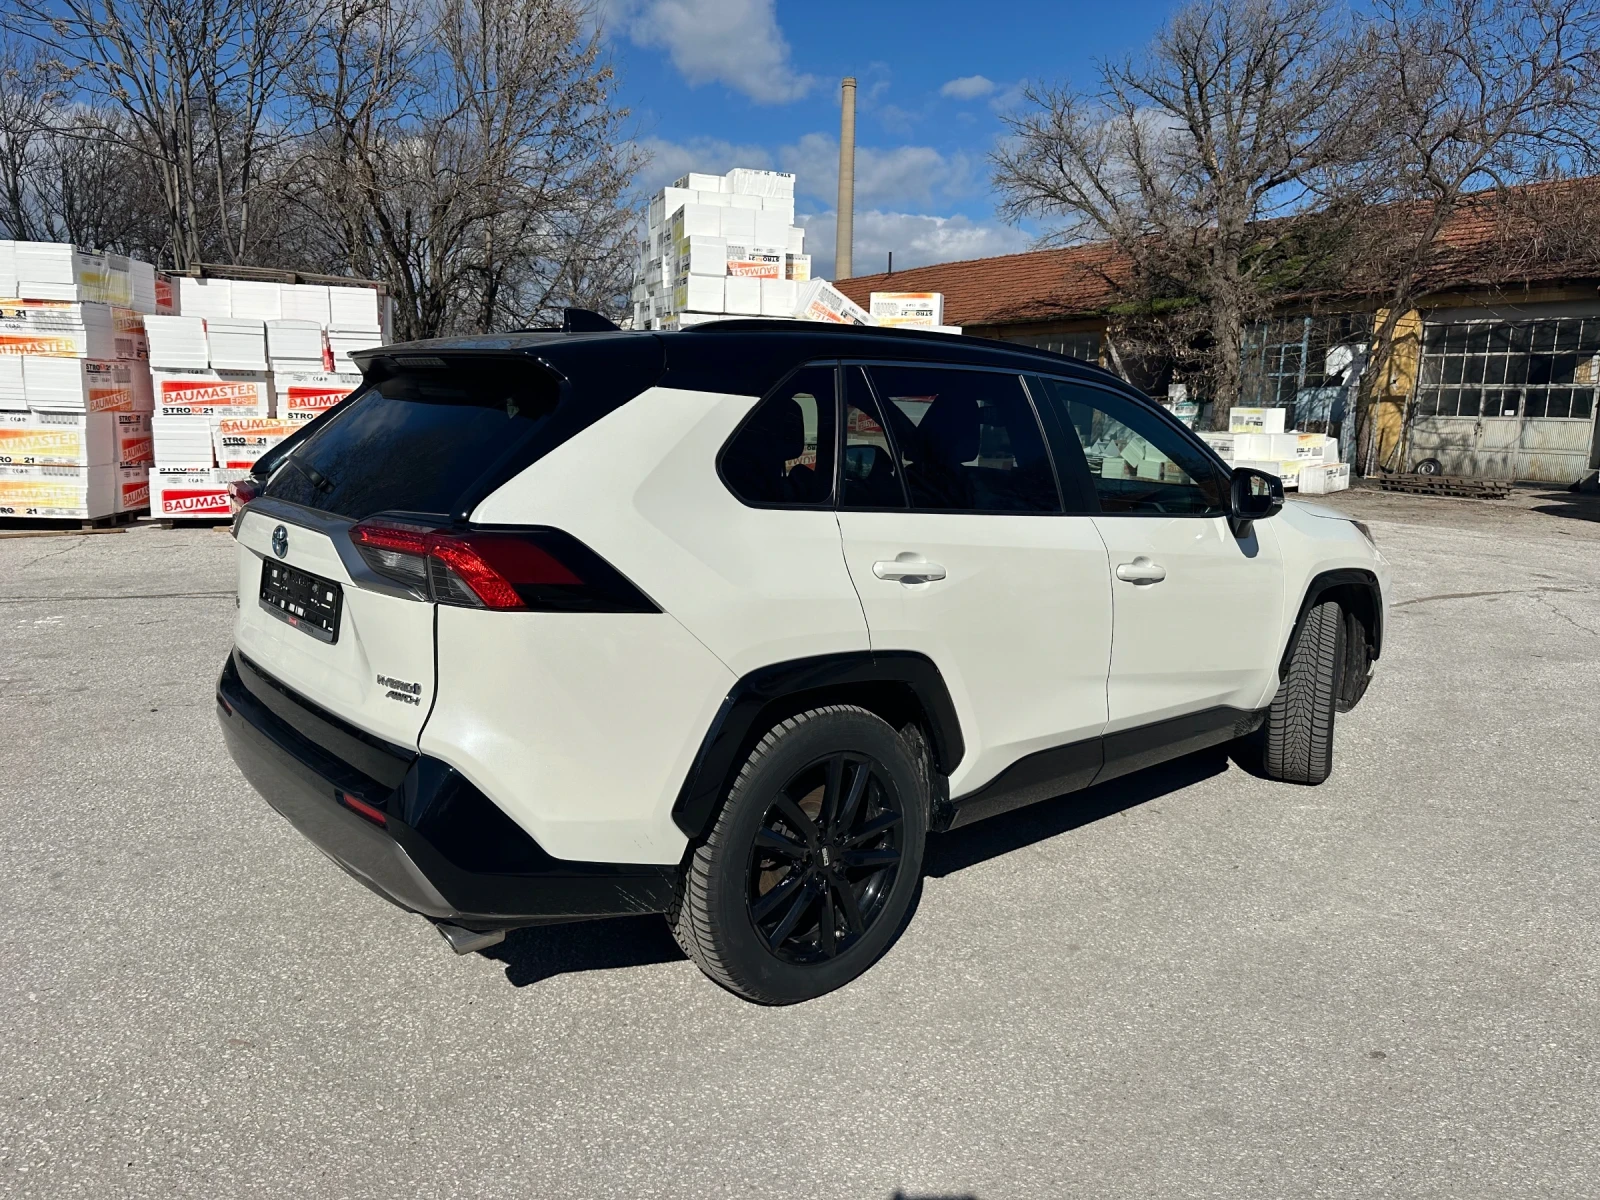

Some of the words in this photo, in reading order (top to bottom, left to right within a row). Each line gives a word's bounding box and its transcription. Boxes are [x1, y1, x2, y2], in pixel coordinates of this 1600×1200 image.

[90, 390, 131, 411] BAUMASTER
[164, 384, 255, 404] BAUMASTER
[164, 494, 230, 511] BAUMAS
